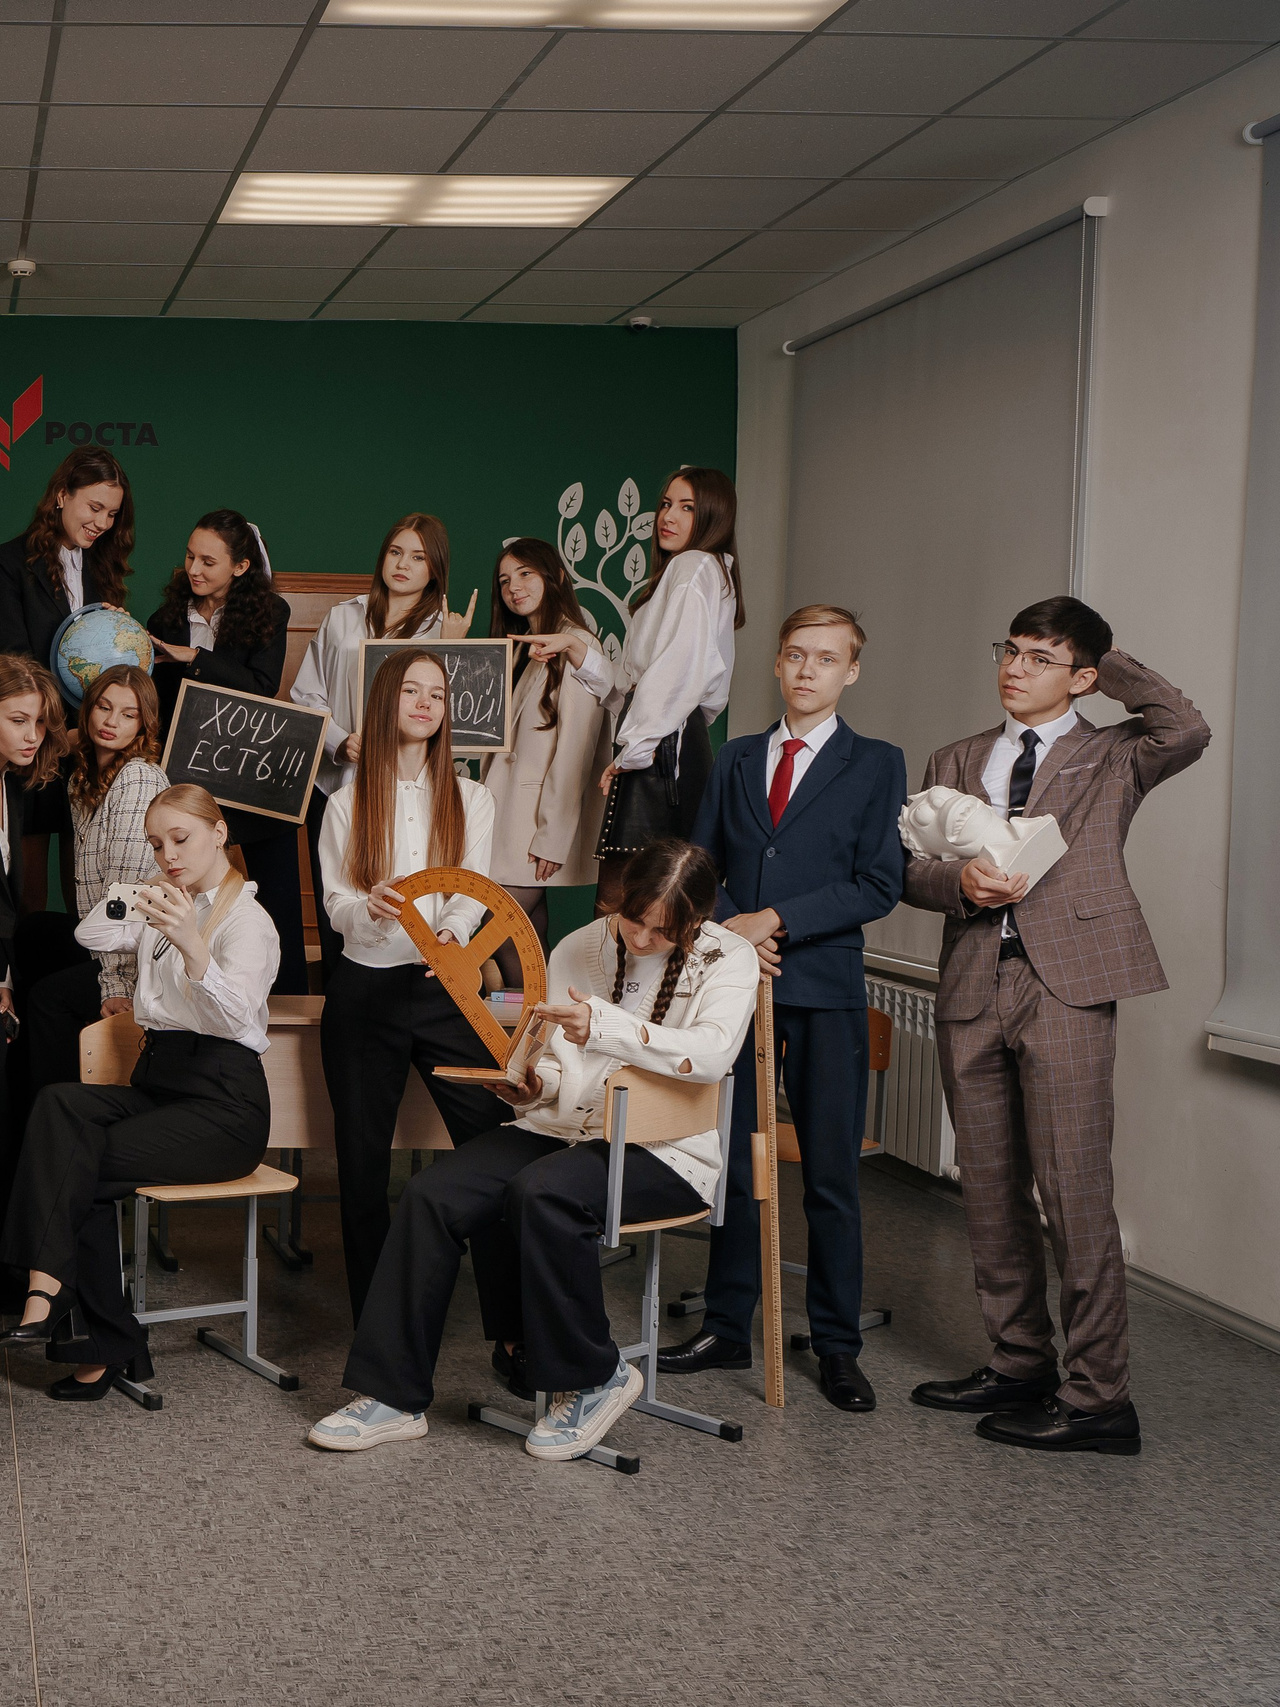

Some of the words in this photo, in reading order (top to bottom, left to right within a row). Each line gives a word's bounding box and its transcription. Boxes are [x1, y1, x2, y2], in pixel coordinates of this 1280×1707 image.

[44, 421, 159, 447] РОСТА
[199, 698, 288, 744] ХОЧУ
[187, 740, 306, 789] ЕСТЬ!!!
